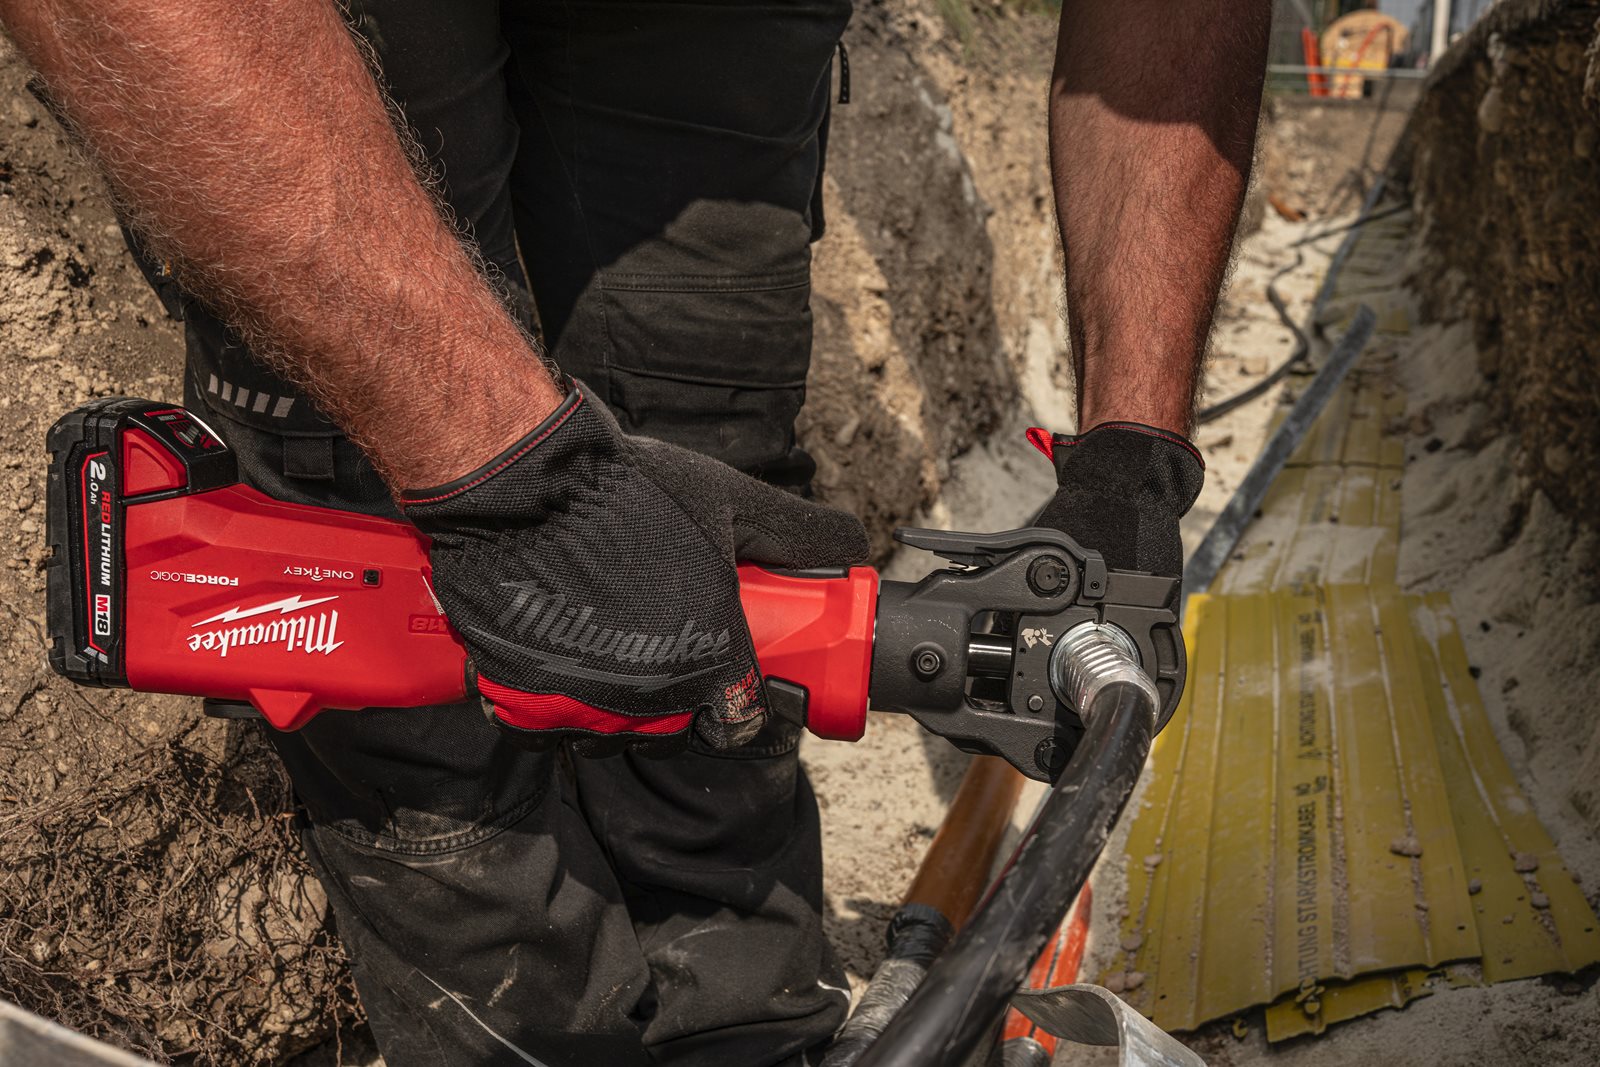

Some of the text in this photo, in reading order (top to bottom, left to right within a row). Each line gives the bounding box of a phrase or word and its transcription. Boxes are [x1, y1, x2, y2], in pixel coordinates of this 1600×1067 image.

[96, 491, 112, 634] REDLITHIUM M18
[150, 569, 239, 587] FORCELOGIC
[185, 609, 344, 658] Milwaukee
[499, 580, 731, 665] Milwaukee
[1297, 800, 1318, 924] STARKSTROMKABEL
